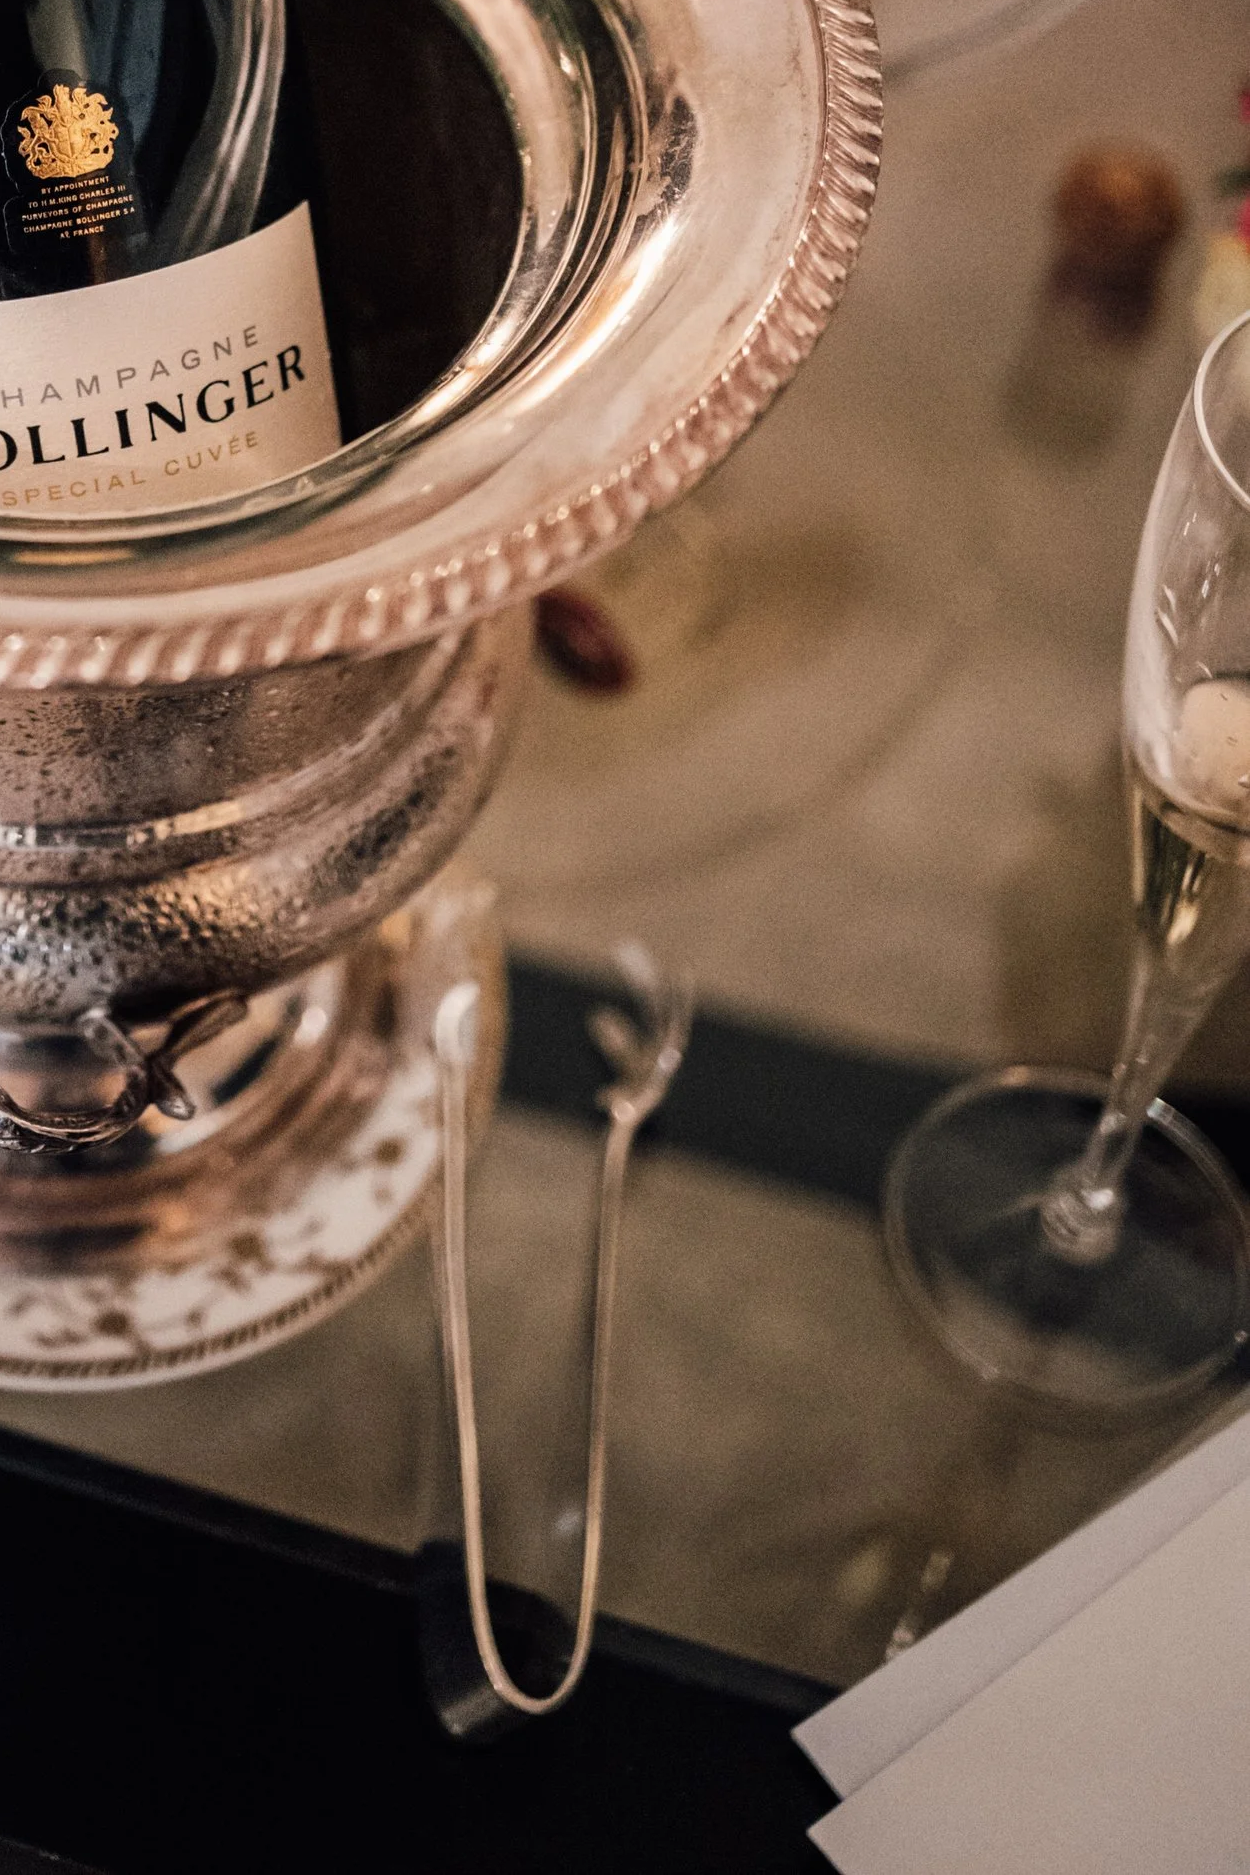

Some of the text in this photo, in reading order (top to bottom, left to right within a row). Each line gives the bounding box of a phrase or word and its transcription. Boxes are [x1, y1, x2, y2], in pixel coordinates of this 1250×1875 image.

[41, 175, 110, 195] BY APPOINTMENT
[21, 194, 134, 222] PURVEYORS OF CHAMPAGNE
[28, 201, 38, 209] TO
[79, 186, 115, 200] CHARLES
[23, 220, 73, 233] CHAMPAGNE
[76, 209, 121, 225] BOLLINGER
[73, 225, 105, 237] FRANCE
[1, 430, 260, 508] SPECIAL CUVÉE
